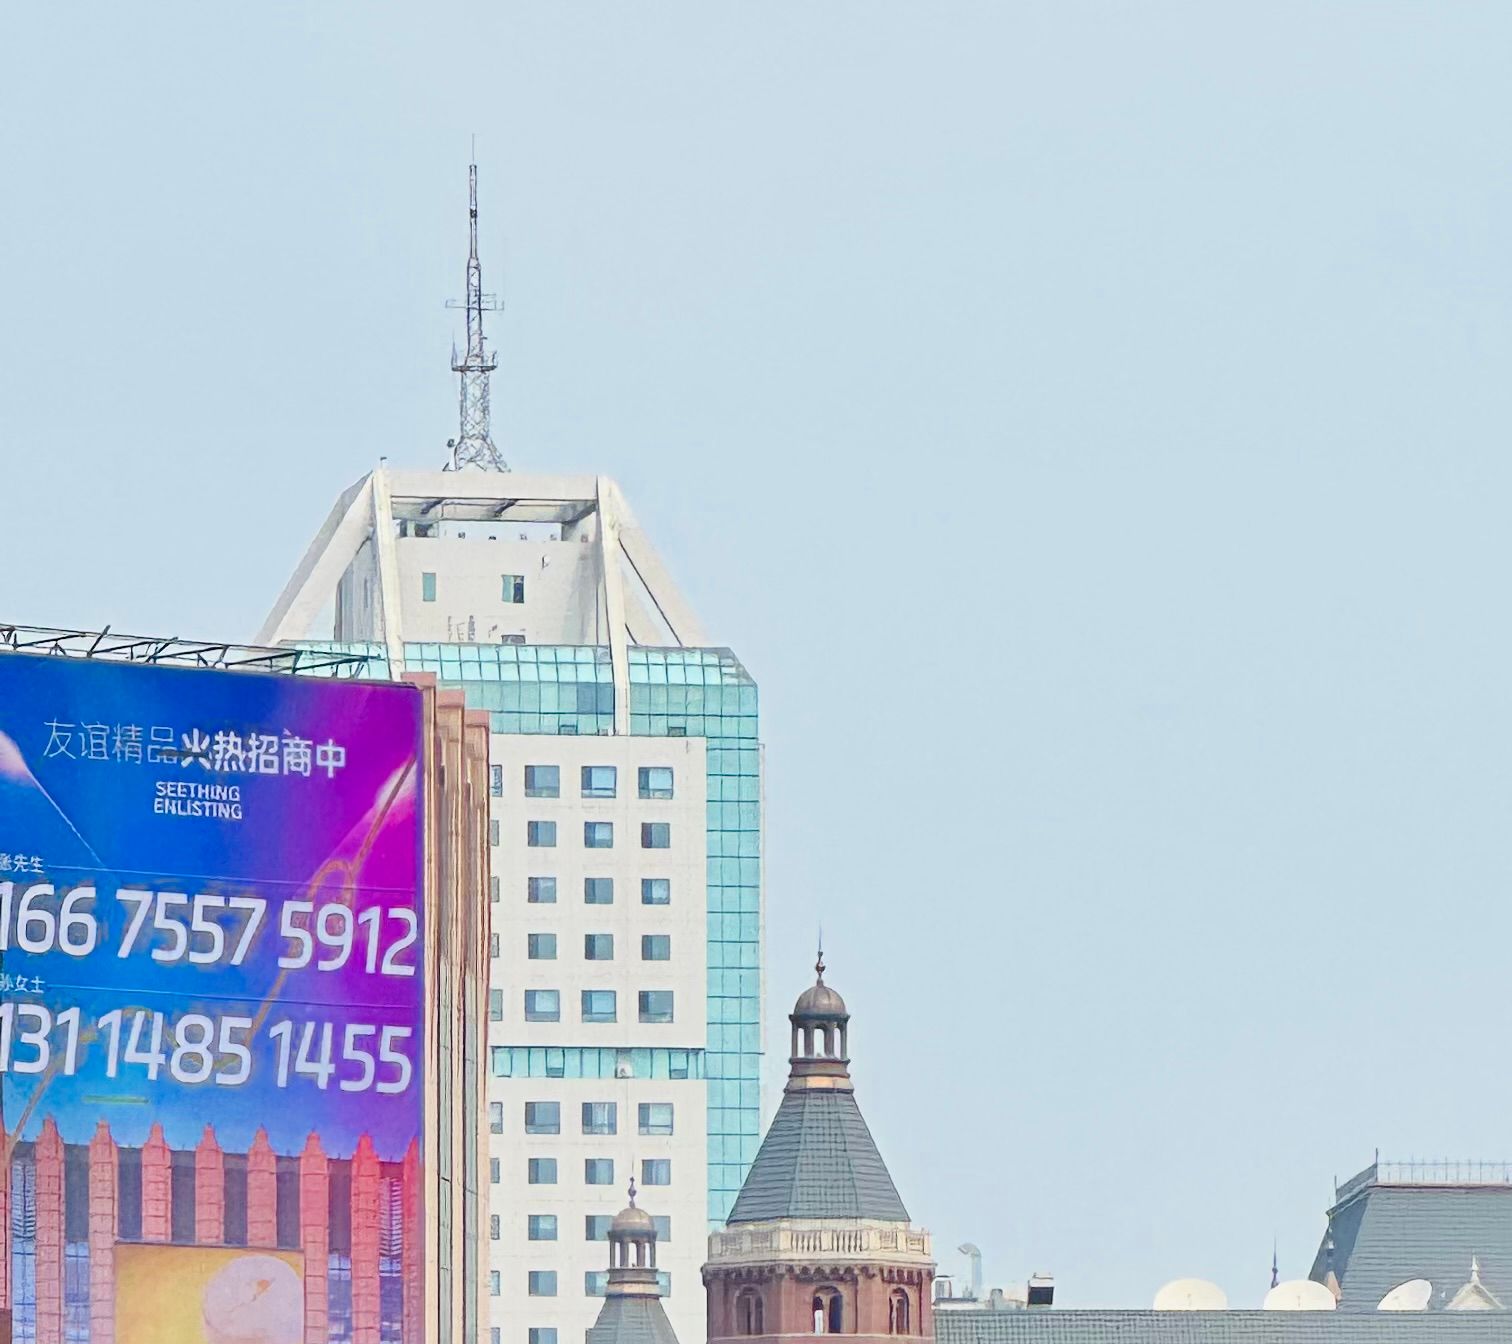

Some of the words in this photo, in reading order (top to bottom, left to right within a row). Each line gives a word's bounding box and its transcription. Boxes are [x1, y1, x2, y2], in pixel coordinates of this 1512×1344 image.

[42, 718, 347, 779] 友谊精品火热招商中
[154, 798, 243, 820] ENLISTING
[155, 781, 241, 801] SEETHING
[116, 889, 267, 966] 7557
[277, 900, 419, 977] 5912
[97, 1007, 253, 1086] 1485
[269, 1019, 413, 1094] 1455
